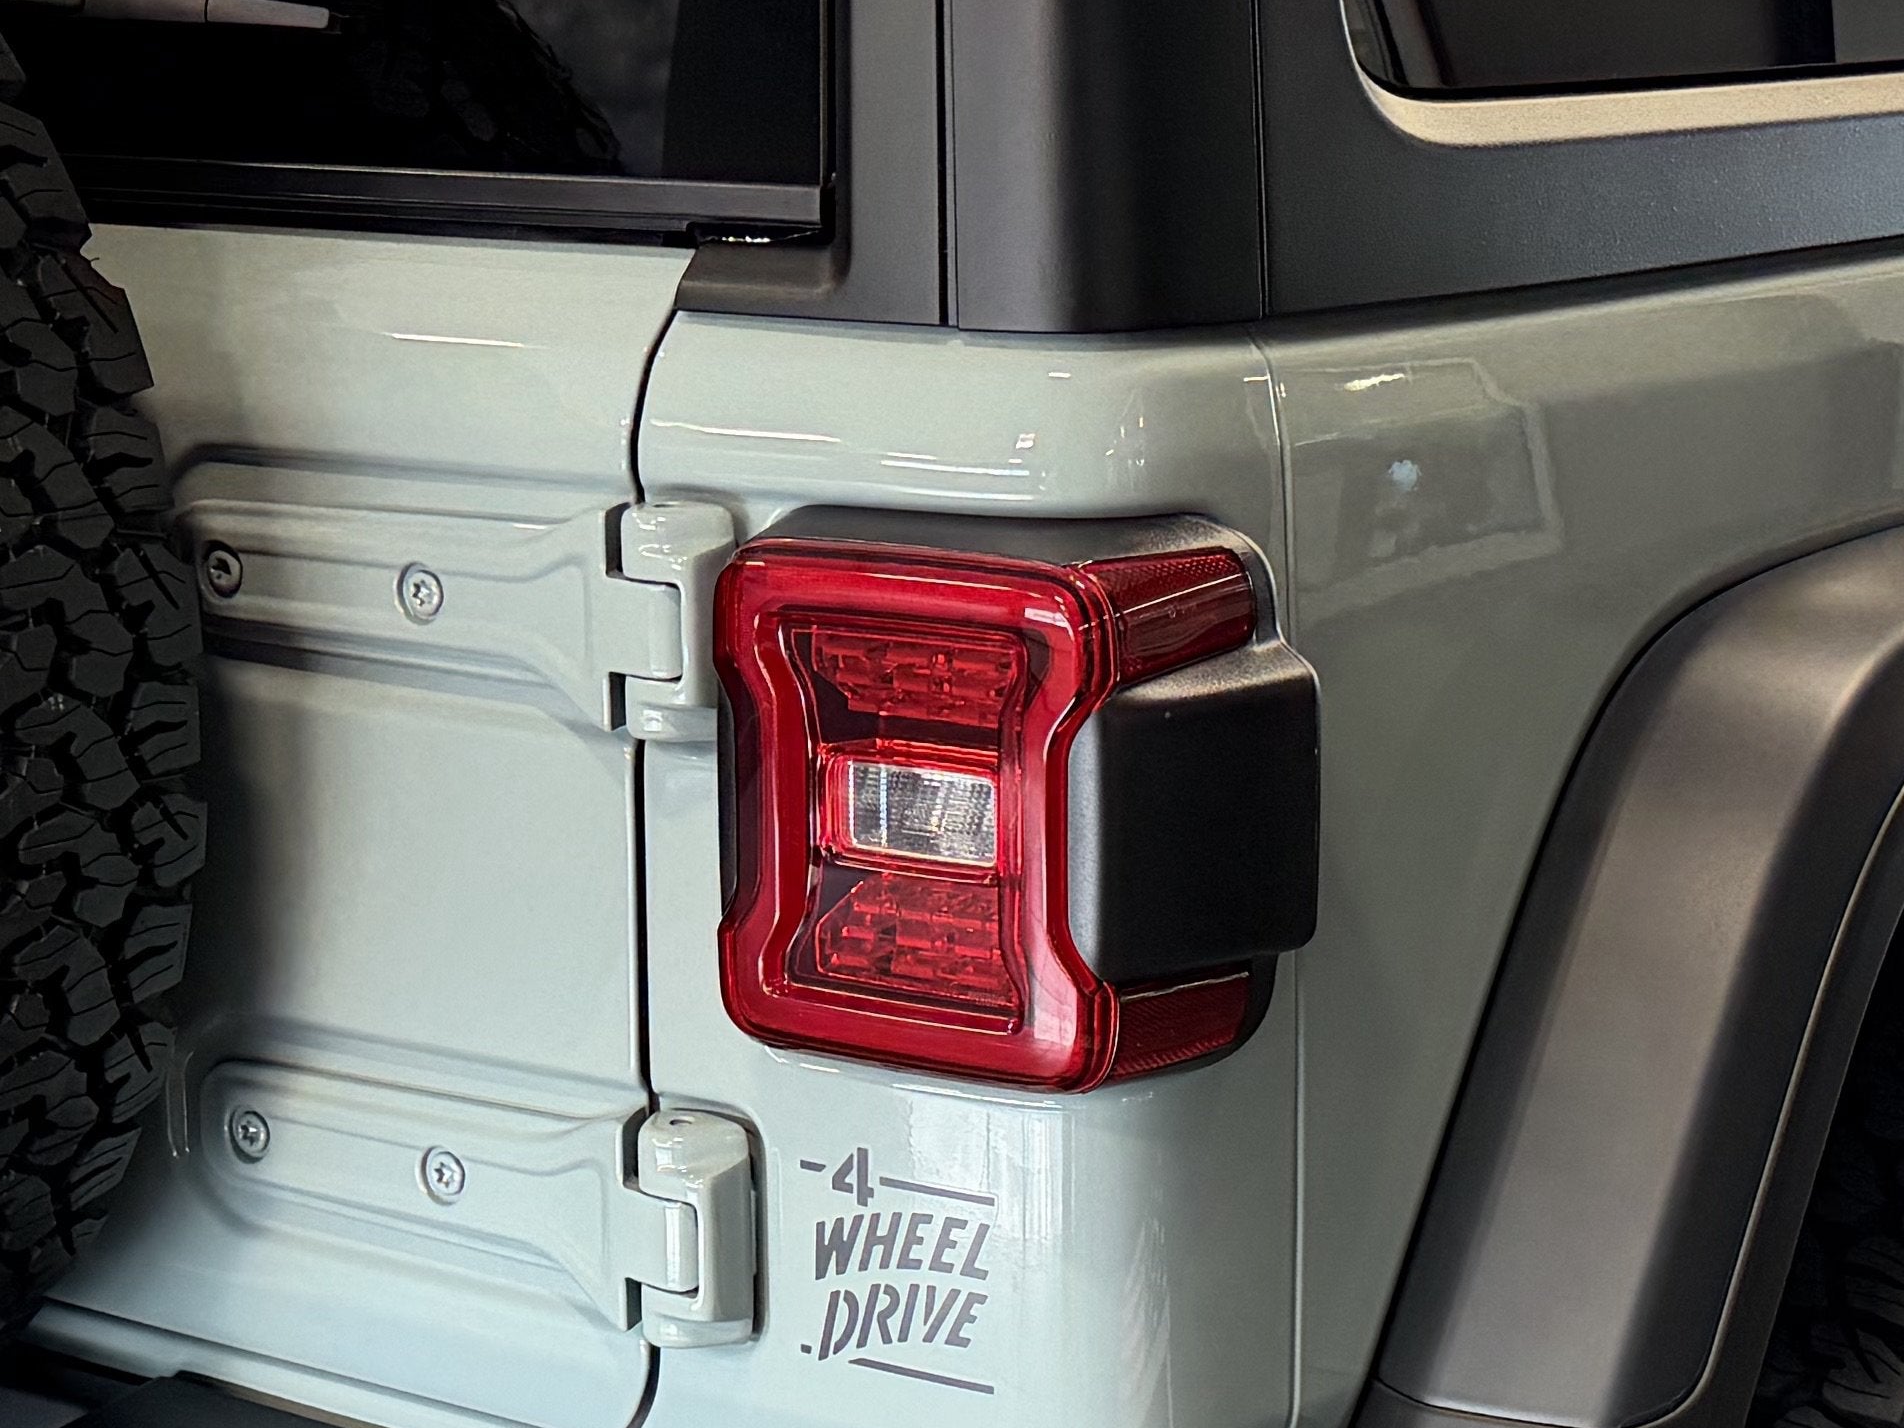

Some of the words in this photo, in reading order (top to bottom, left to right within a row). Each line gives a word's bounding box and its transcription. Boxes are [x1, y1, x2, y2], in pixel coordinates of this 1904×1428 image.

[832, 1147, 874, 1207] 4
[815, 1211, 990, 1281] WHEEL
[818, 1283, 988, 1361] DRIVE
